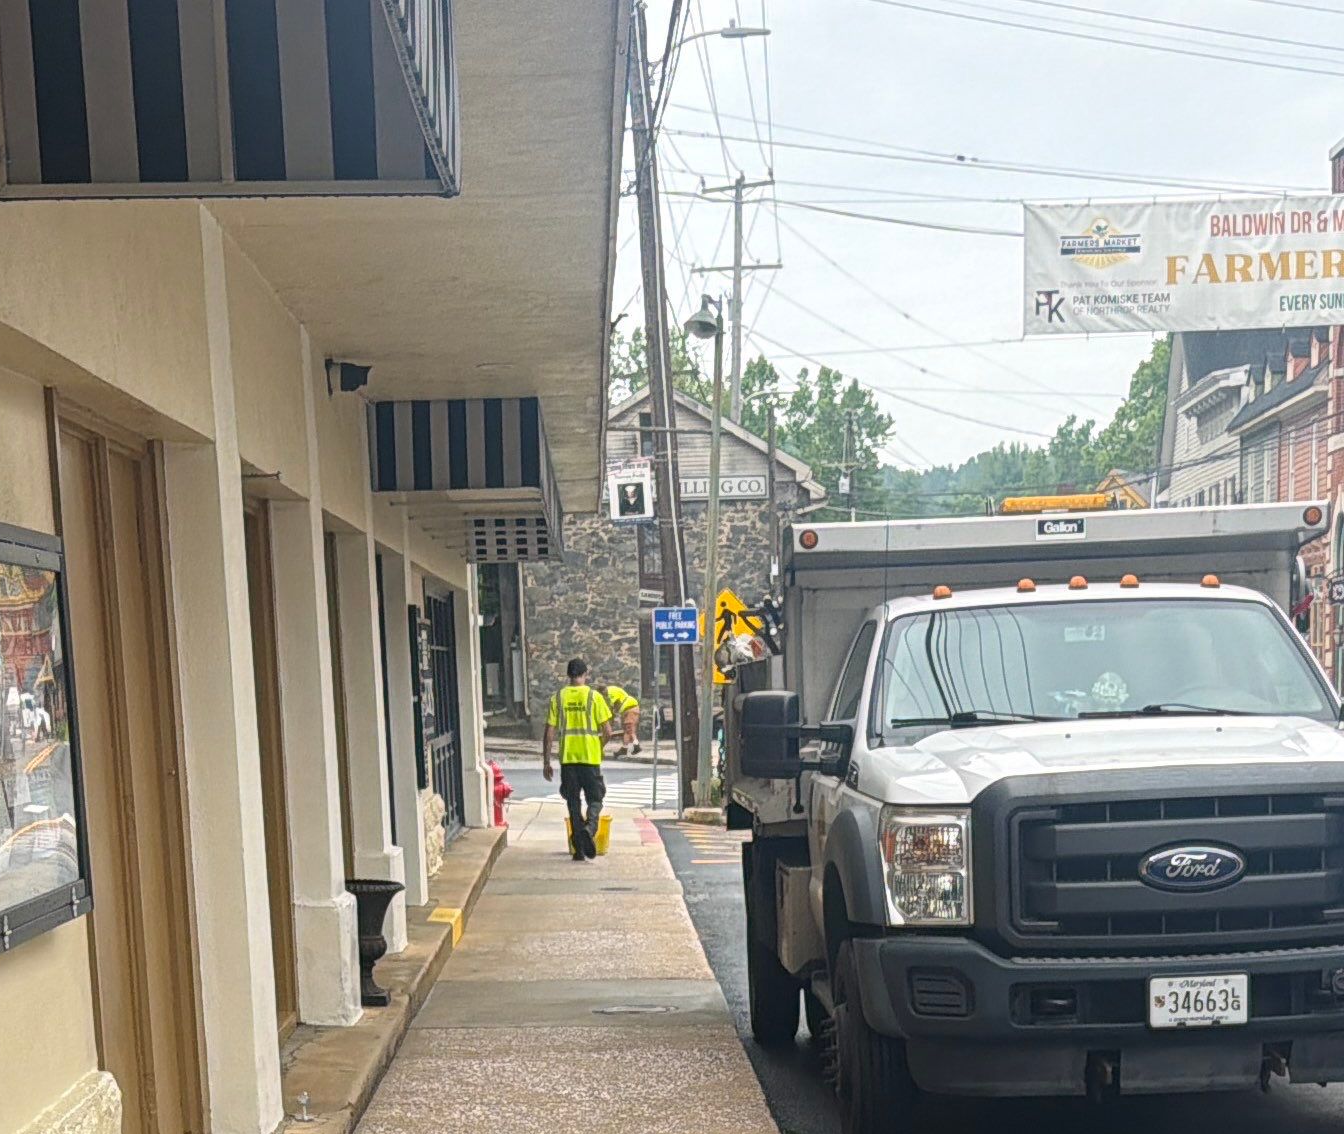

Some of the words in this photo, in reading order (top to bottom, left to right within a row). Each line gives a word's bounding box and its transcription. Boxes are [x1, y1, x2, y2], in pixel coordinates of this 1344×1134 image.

[1210, 211, 1286, 238] BALDWIN
[1291, 210, 1312, 234] DR
[1316, 210, 1329, 233] &
[1061, 239, 1099, 248] FARMERS
[1103, 238, 1138, 247] MARKET
[1072, 295, 1091, 305] PAT
[1093, 293, 1139, 305] KOMISKE
[1141, 292, 1171, 303] TEAM
[1279, 295, 1317, 312] EVERY
[1072, 306, 1085, 316] OF
[1137, 304, 1171, 314] REALTY
[737, 480, 763, 493] CO.
[1165, 854, 1222, 878] Ford
[1179, 979, 1217, 989] Maryland
[1168, 988, 1229, 1014] 34663
